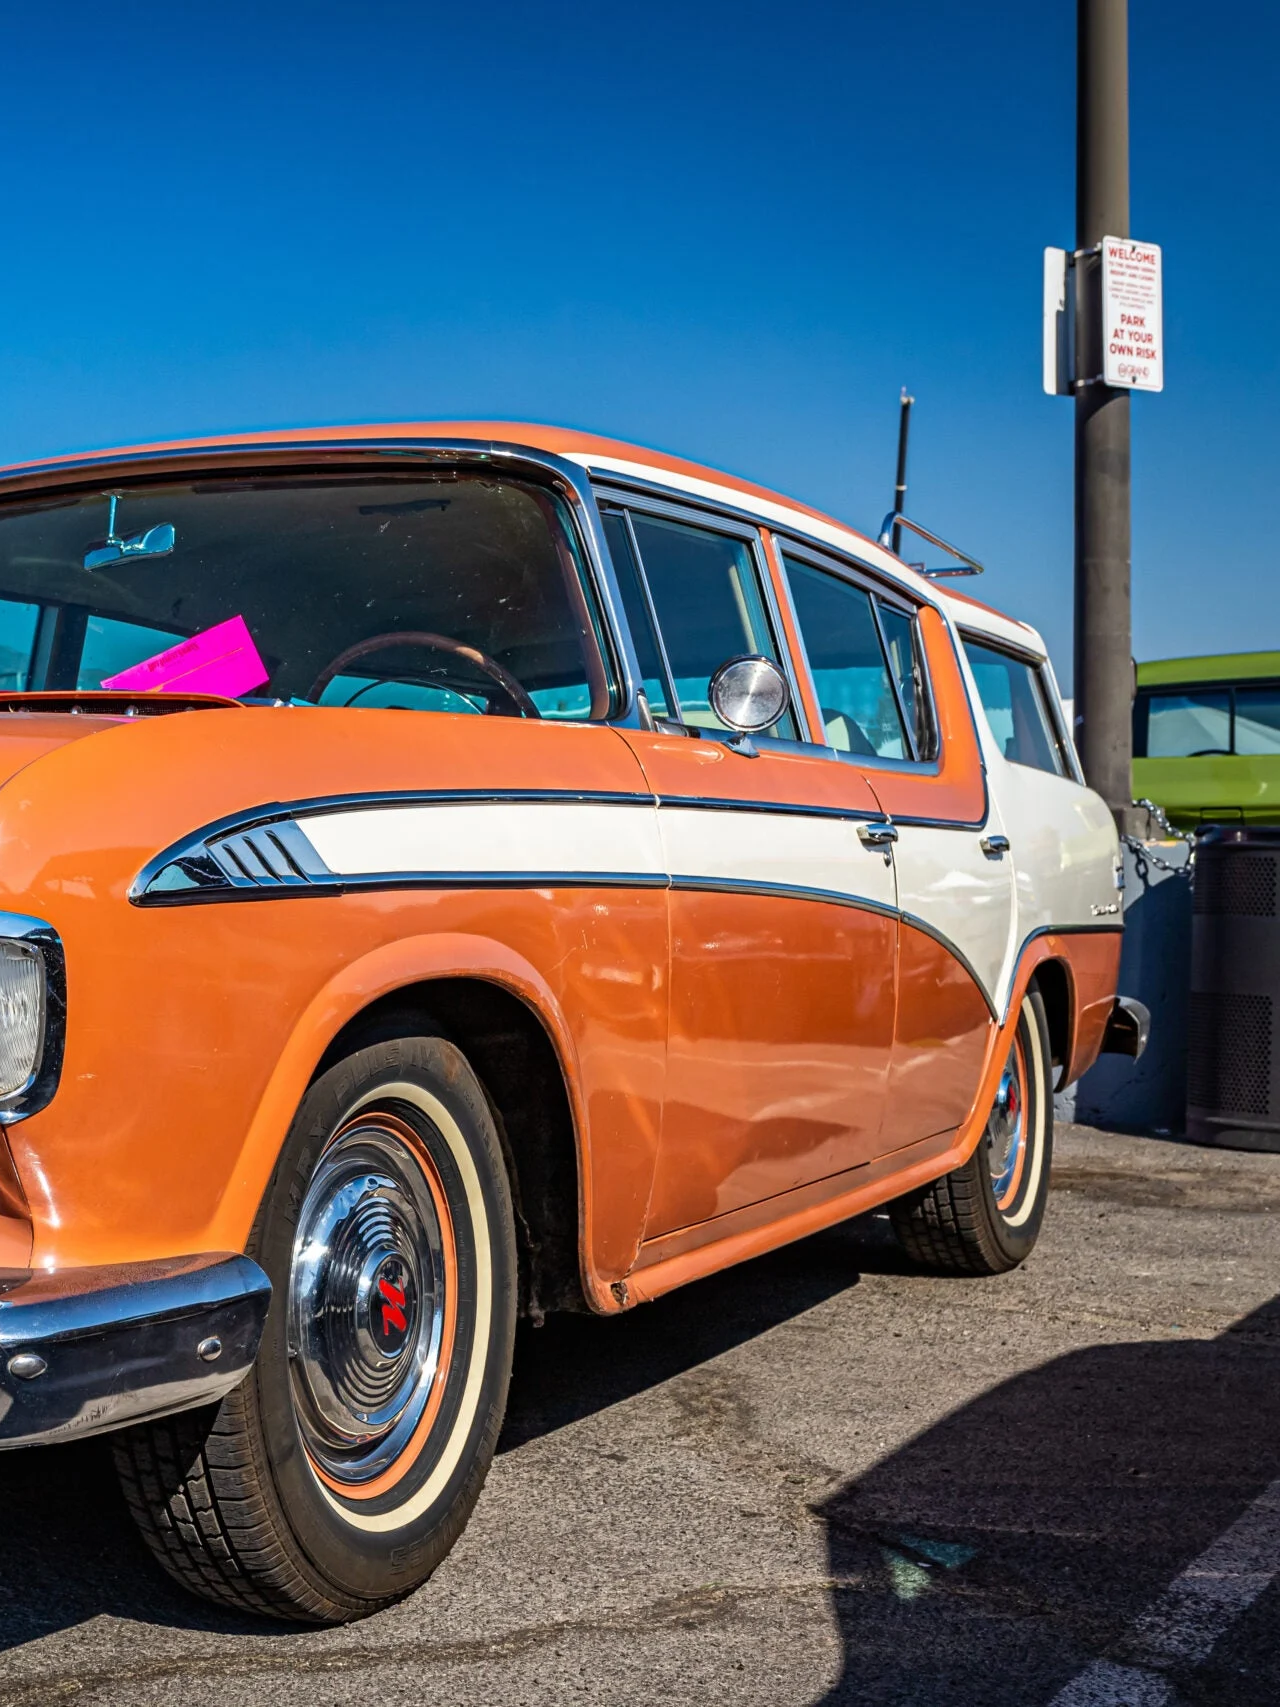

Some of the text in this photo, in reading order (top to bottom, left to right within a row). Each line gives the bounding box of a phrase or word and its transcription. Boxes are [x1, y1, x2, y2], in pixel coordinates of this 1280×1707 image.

[1108, 246, 1156, 265] WELCOME
[1120, 314, 1145, 328] PARK
[1113, 329, 1153, 343] AT YOUR
[1109, 344, 1156, 360] OWN RISK
